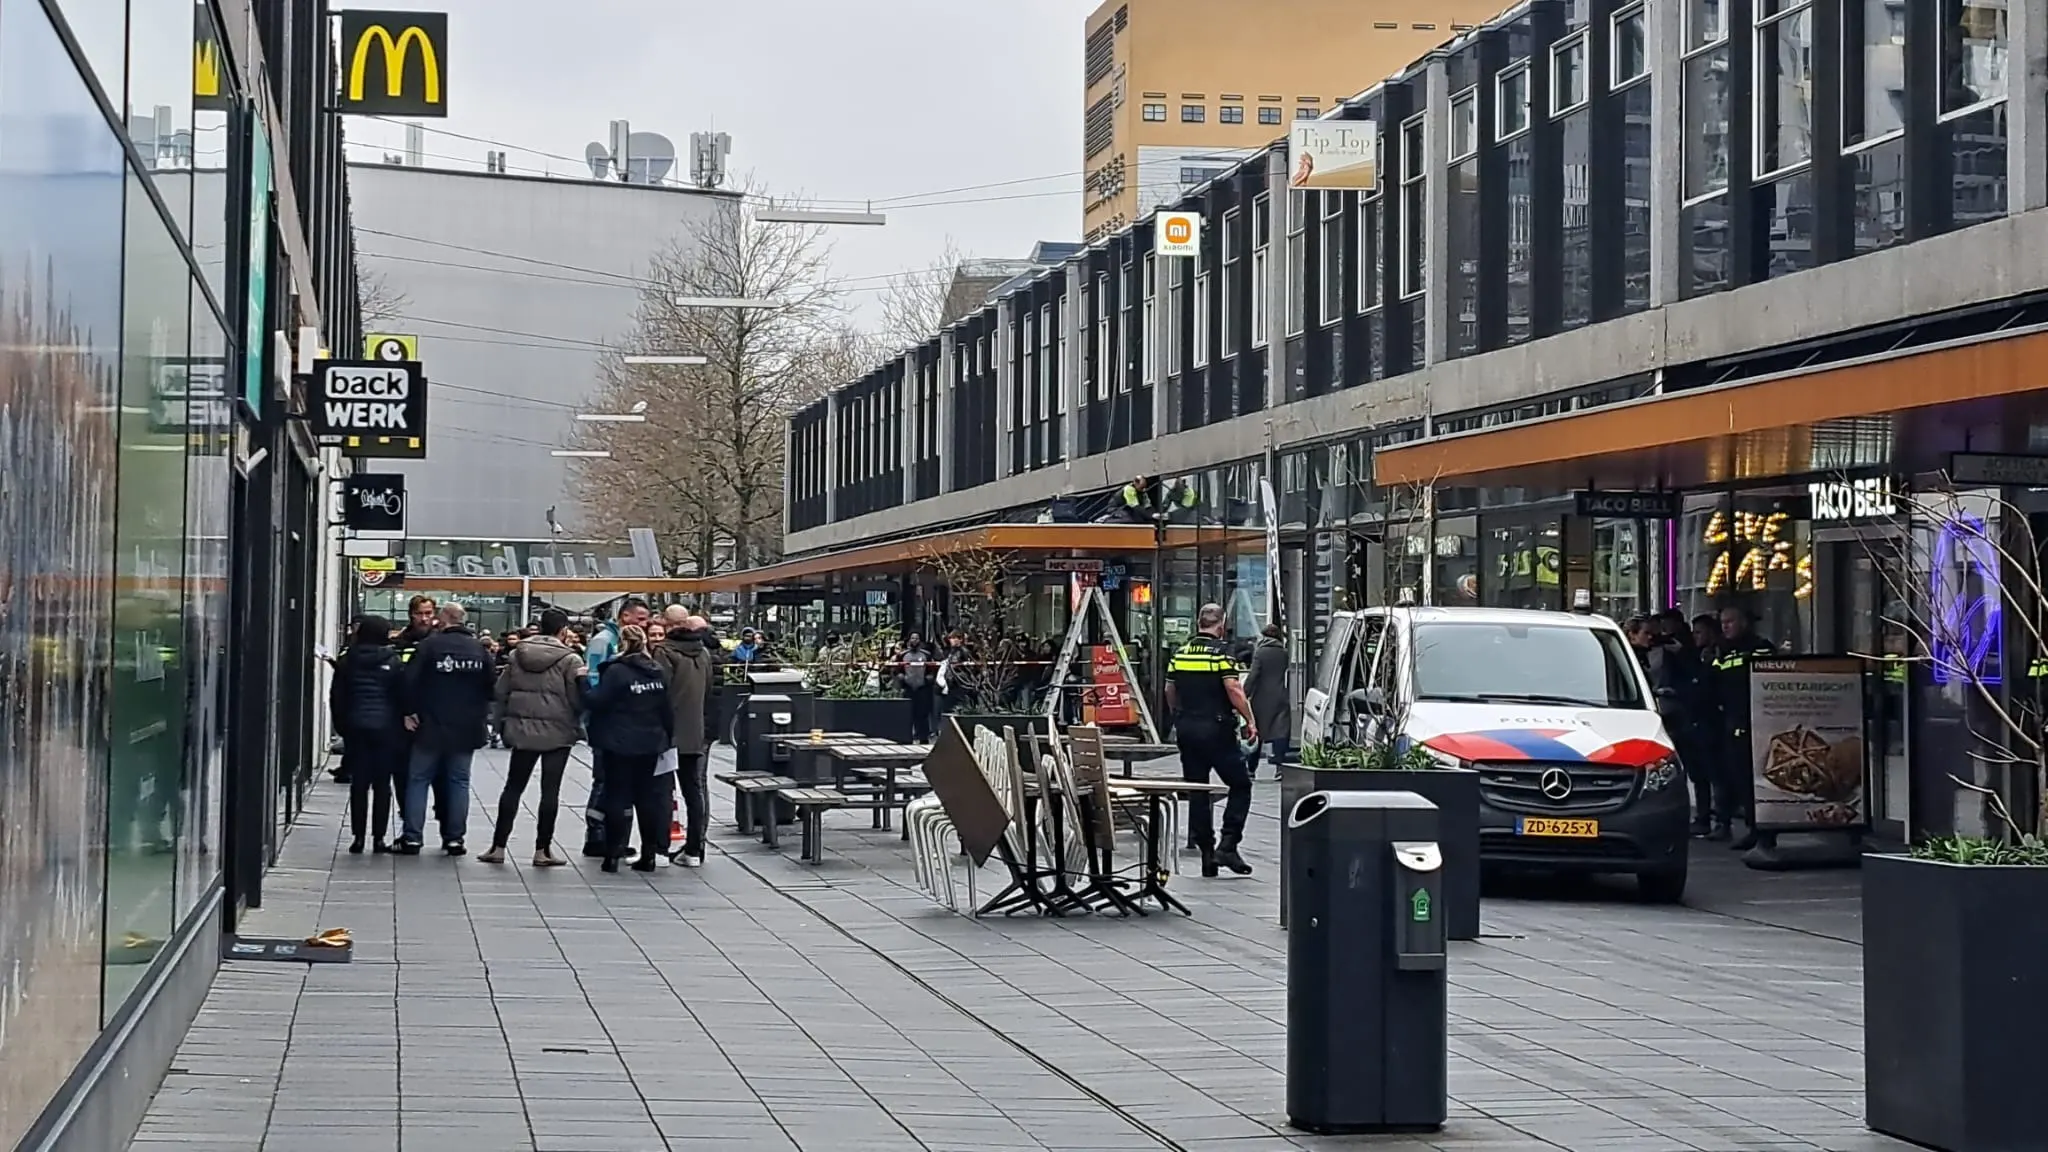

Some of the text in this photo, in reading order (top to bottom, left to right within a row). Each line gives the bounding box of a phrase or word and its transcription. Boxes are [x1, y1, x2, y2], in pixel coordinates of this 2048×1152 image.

[1298, 128, 1370, 155] Tip Top
[331, 370, 403, 395] back
[324, 402, 408, 429] WERK
[1585, 498, 1672, 513] TACO BELL
[1809, 476, 1896, 519] TACO BELL
[1755, 660, 1797, 669] NIEUW
[1500, 717, 1592, 727] POLITIE
[1527, 820, 1594, 834] ZD-625-X
